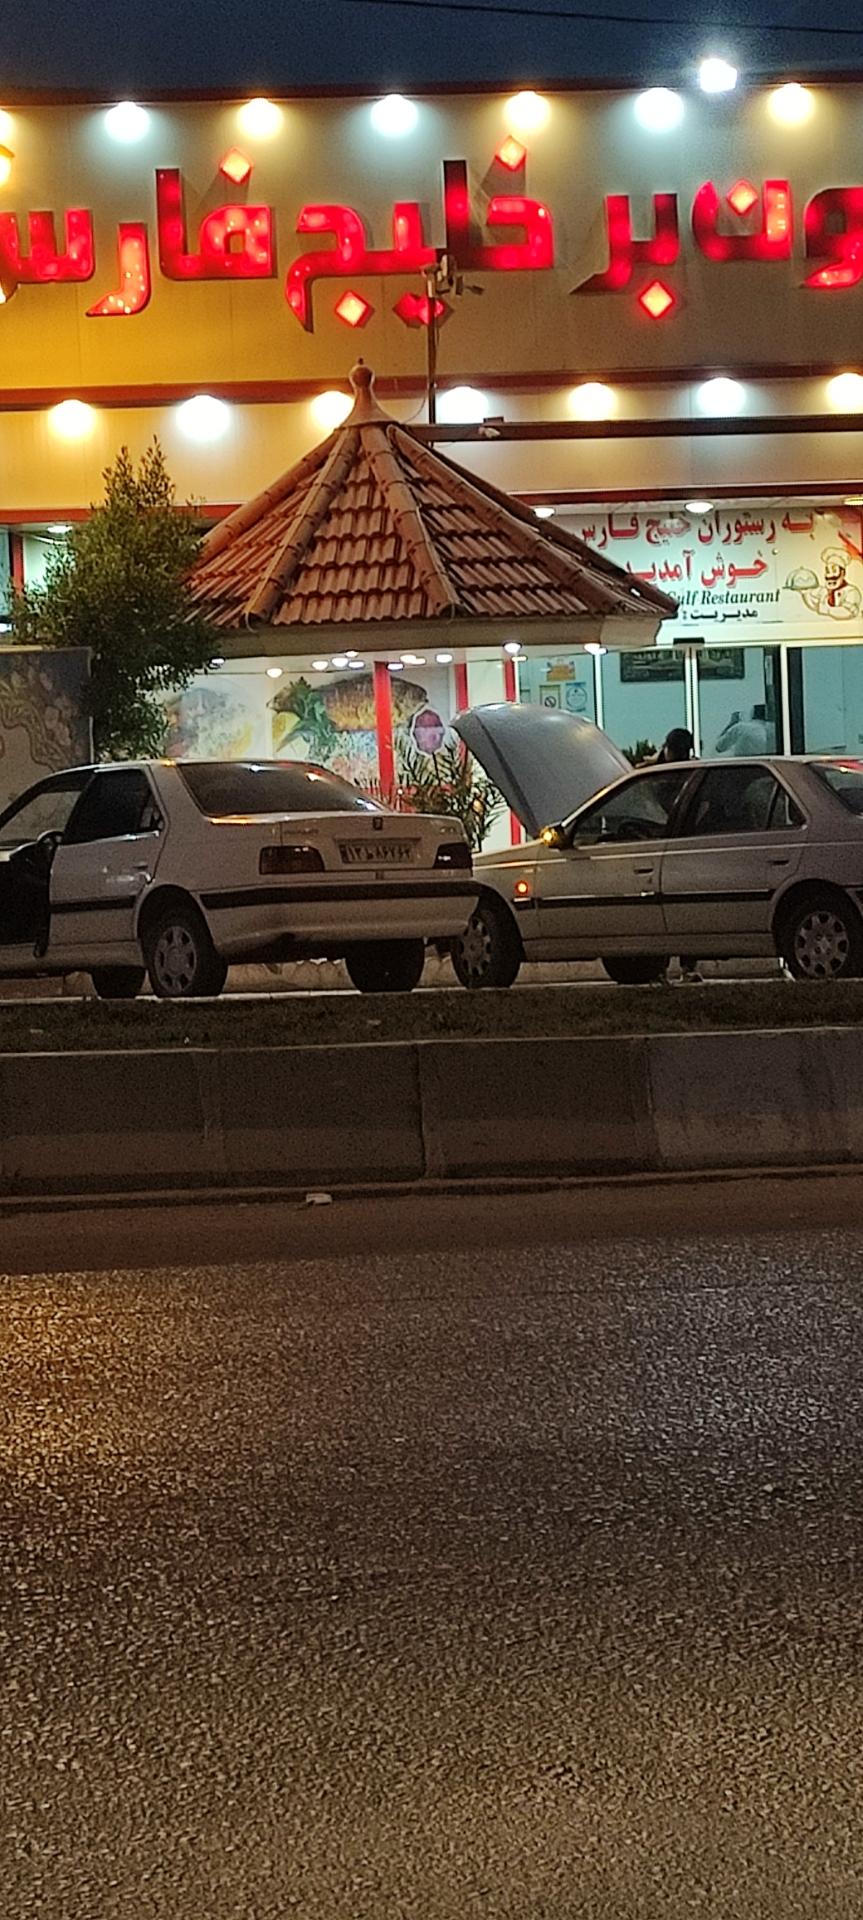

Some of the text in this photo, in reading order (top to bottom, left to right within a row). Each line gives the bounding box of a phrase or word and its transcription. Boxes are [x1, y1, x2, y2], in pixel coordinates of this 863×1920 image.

[285, 134, 555, 334] خلیج
[645, 512, 691, 545] خلیج
[697, 510, 776, 545] رستوران
[626, 549, 769, 587] خوش آمدید
[701, 589, 780, 606] Restaurant
